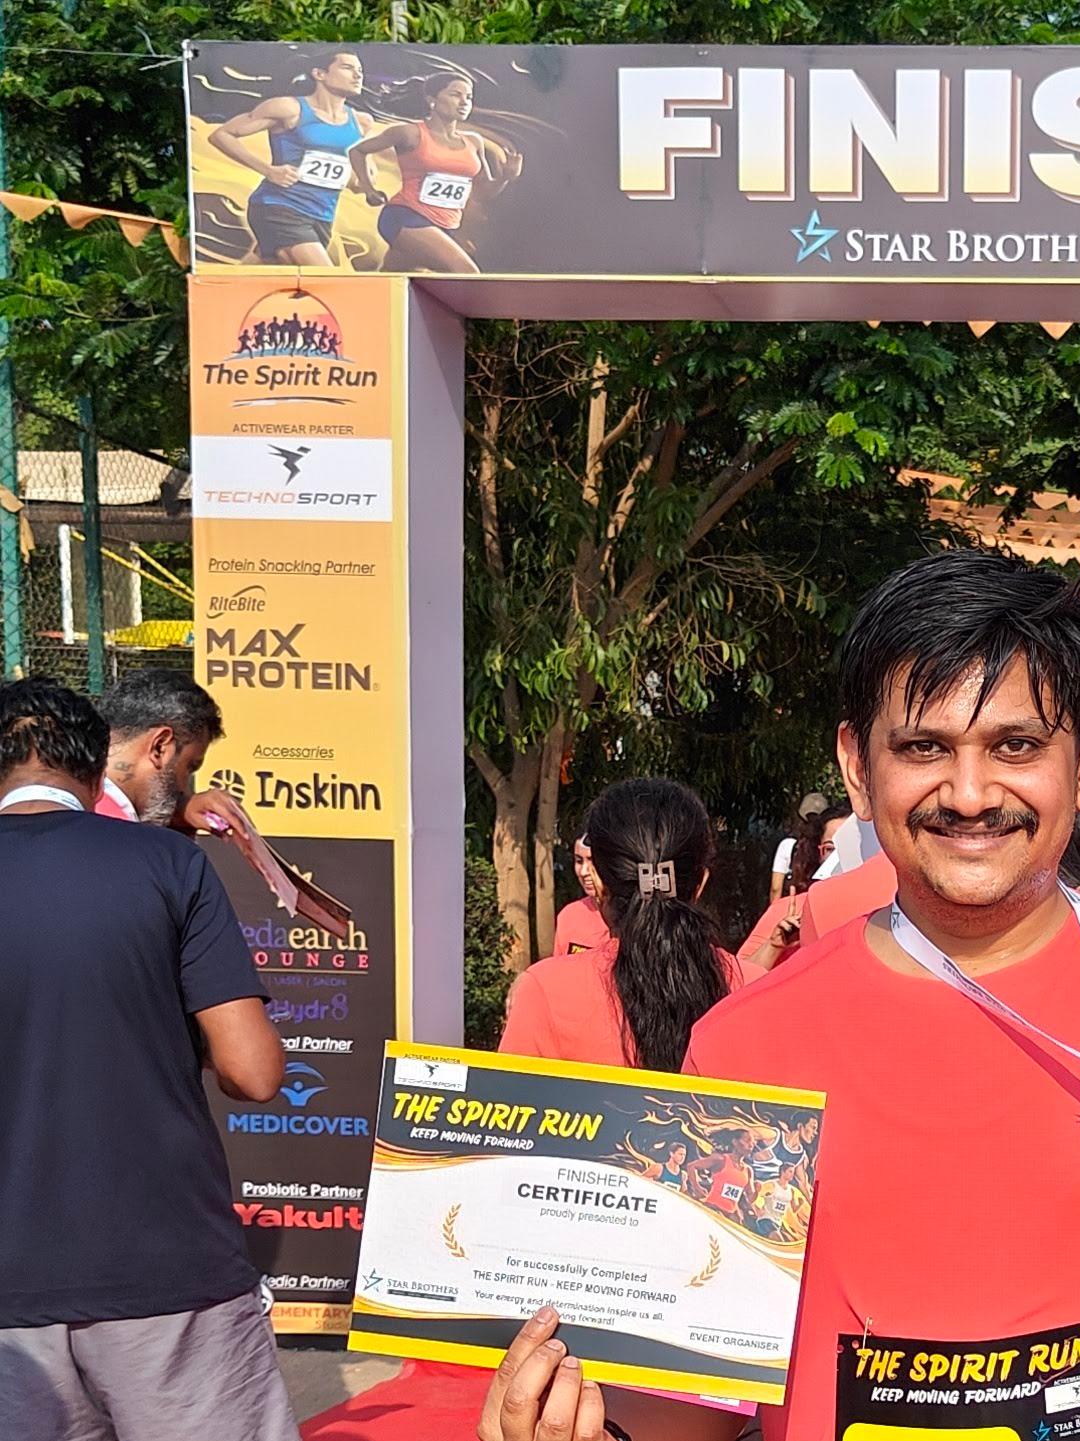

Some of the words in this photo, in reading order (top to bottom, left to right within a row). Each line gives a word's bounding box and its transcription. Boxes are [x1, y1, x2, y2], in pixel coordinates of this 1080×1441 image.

[306, 159, 345, 181] 219
[427, 180, 466, 202] 248
[846, 228, 938, 263] STAR
[203, 363, 249, 385] The
[255, 363, 321, 391] Spirit
[327, 366, 378, 388] Run
[232, 423, 307, 435] ACTIVEWEAR
[309, 424, 354, 435] PARTER
[203, 490, 378, 506] TECHNOSPORT
[208, 558, 255, 572] Protein
[258, 559, 321, 576] Snacking
[324, 560, 376, 575] Partner
[209, 596, 266, 612] RiteBite
[206, 623, 306, 658] MAX
[253, 744, 335, 759] Accessaries
[254, 771, 382, 811] Inskinn
[254, 951, 369, 969] OUNGE
[302, 1036, 354, 1052] Partner
[227, 1112, 370, 1136] MEDICOVER
[392, 1092, 446, 1125] THE
[446, 1096, 537, 1135] SPIRIT
[538, 1108, 604, 1142] RUN
[410, 1127, 440, 1140] KEEP
[440, 1130, 482, 1146] MOVING
[483, 1135, 535, 1151] FORWARD
[557, 1168, 630, 1189] FINISHER
[242, 1181, 308, 1197] Probiotic
[310, 1183, 364, 1198] Partner
[517, 1183, 658, 1214] CERTIFICATE
[233, 1202, 365, 1231] Yakult
[539, 1206, 576, 1221] proudly
[578, 1211, 627, 1226] presented
[629, 1217, 640, 1227] to
[506, 1255, 522, 1267] for
[523, 1259, 589, 1277] successfully
[590, 1265, 648, 1283] Completed
[300, 1275, 351, 1290] Partner
[386, 1278, 409, 1289] STAR
[411, 1280, 459, 1295] BROTHERS
[473, 1269, 493, 1281] THE
[493, 1272, 525, 1285] SPIRIT
[526, 1276, 548, 1288] RUN
[556, 1279, 583, 1292] KEEP
[584, 1284, 624, 1297] MOVING
[626, 1288, 677, 1304] FORWARD
[474, 1289, 495, 1301] Your
[526, 1297, 543, 1306] and
[689, 1332, 720, 1344] EVENT
[722, 1336, 779, 1352] ORGANISER
[855, 1347, 906, 1384] THE
[909, 1348, 1020, 1384] SPIRIT
[870, 1385, 904, 1403] KEEP
[906, 1387, 960, 1405] MOVING
[964, 1380, 1042, 1405] FORWARD
[1053, 1421, 1074, 1433] STAR
